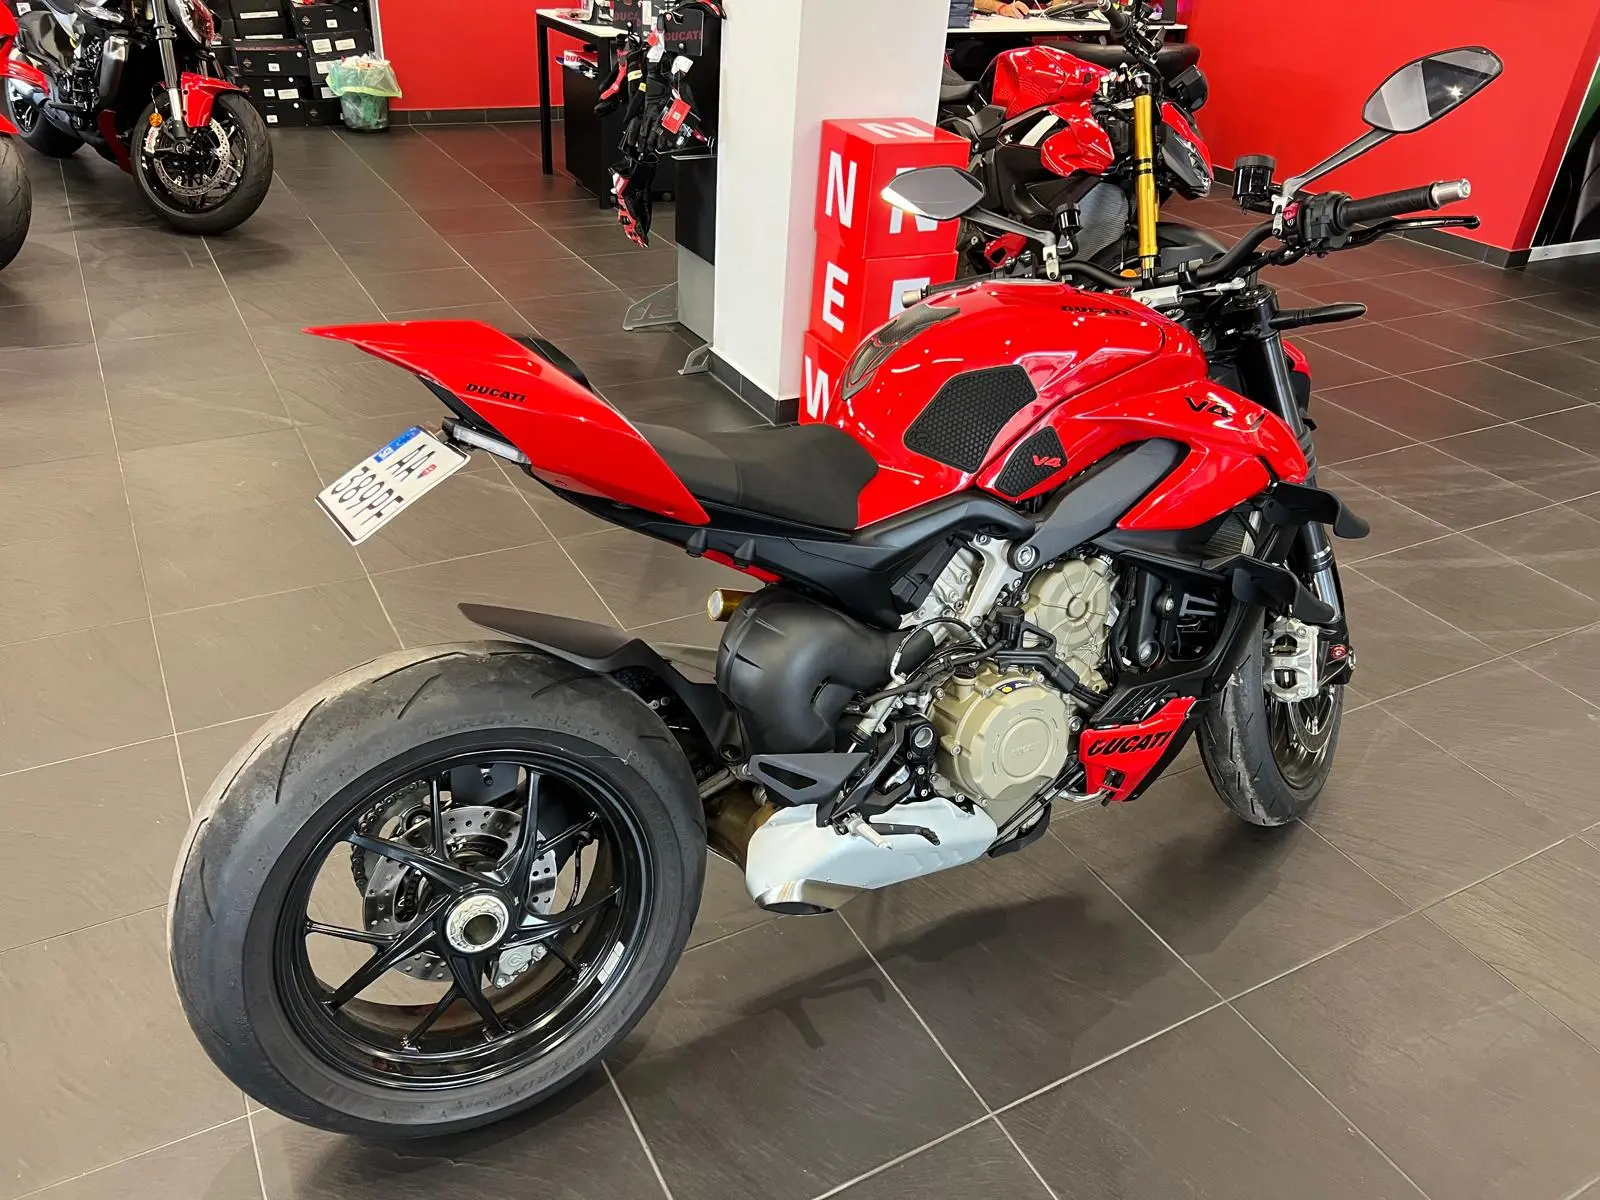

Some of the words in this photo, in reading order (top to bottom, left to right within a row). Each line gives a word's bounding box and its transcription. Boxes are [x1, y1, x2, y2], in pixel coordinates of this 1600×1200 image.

[1061, 306, 1130, 316] DUCATI
[465, 383, 527, 403] DUCATI
[1184, 396, 1233, 418] V4
[385, 443, 436, 482] AA
[1032, 454, 1062, 468] V4
[330, 466, 405, 527] 389PF
[1087, 729, 1174, 757] DUCATI
